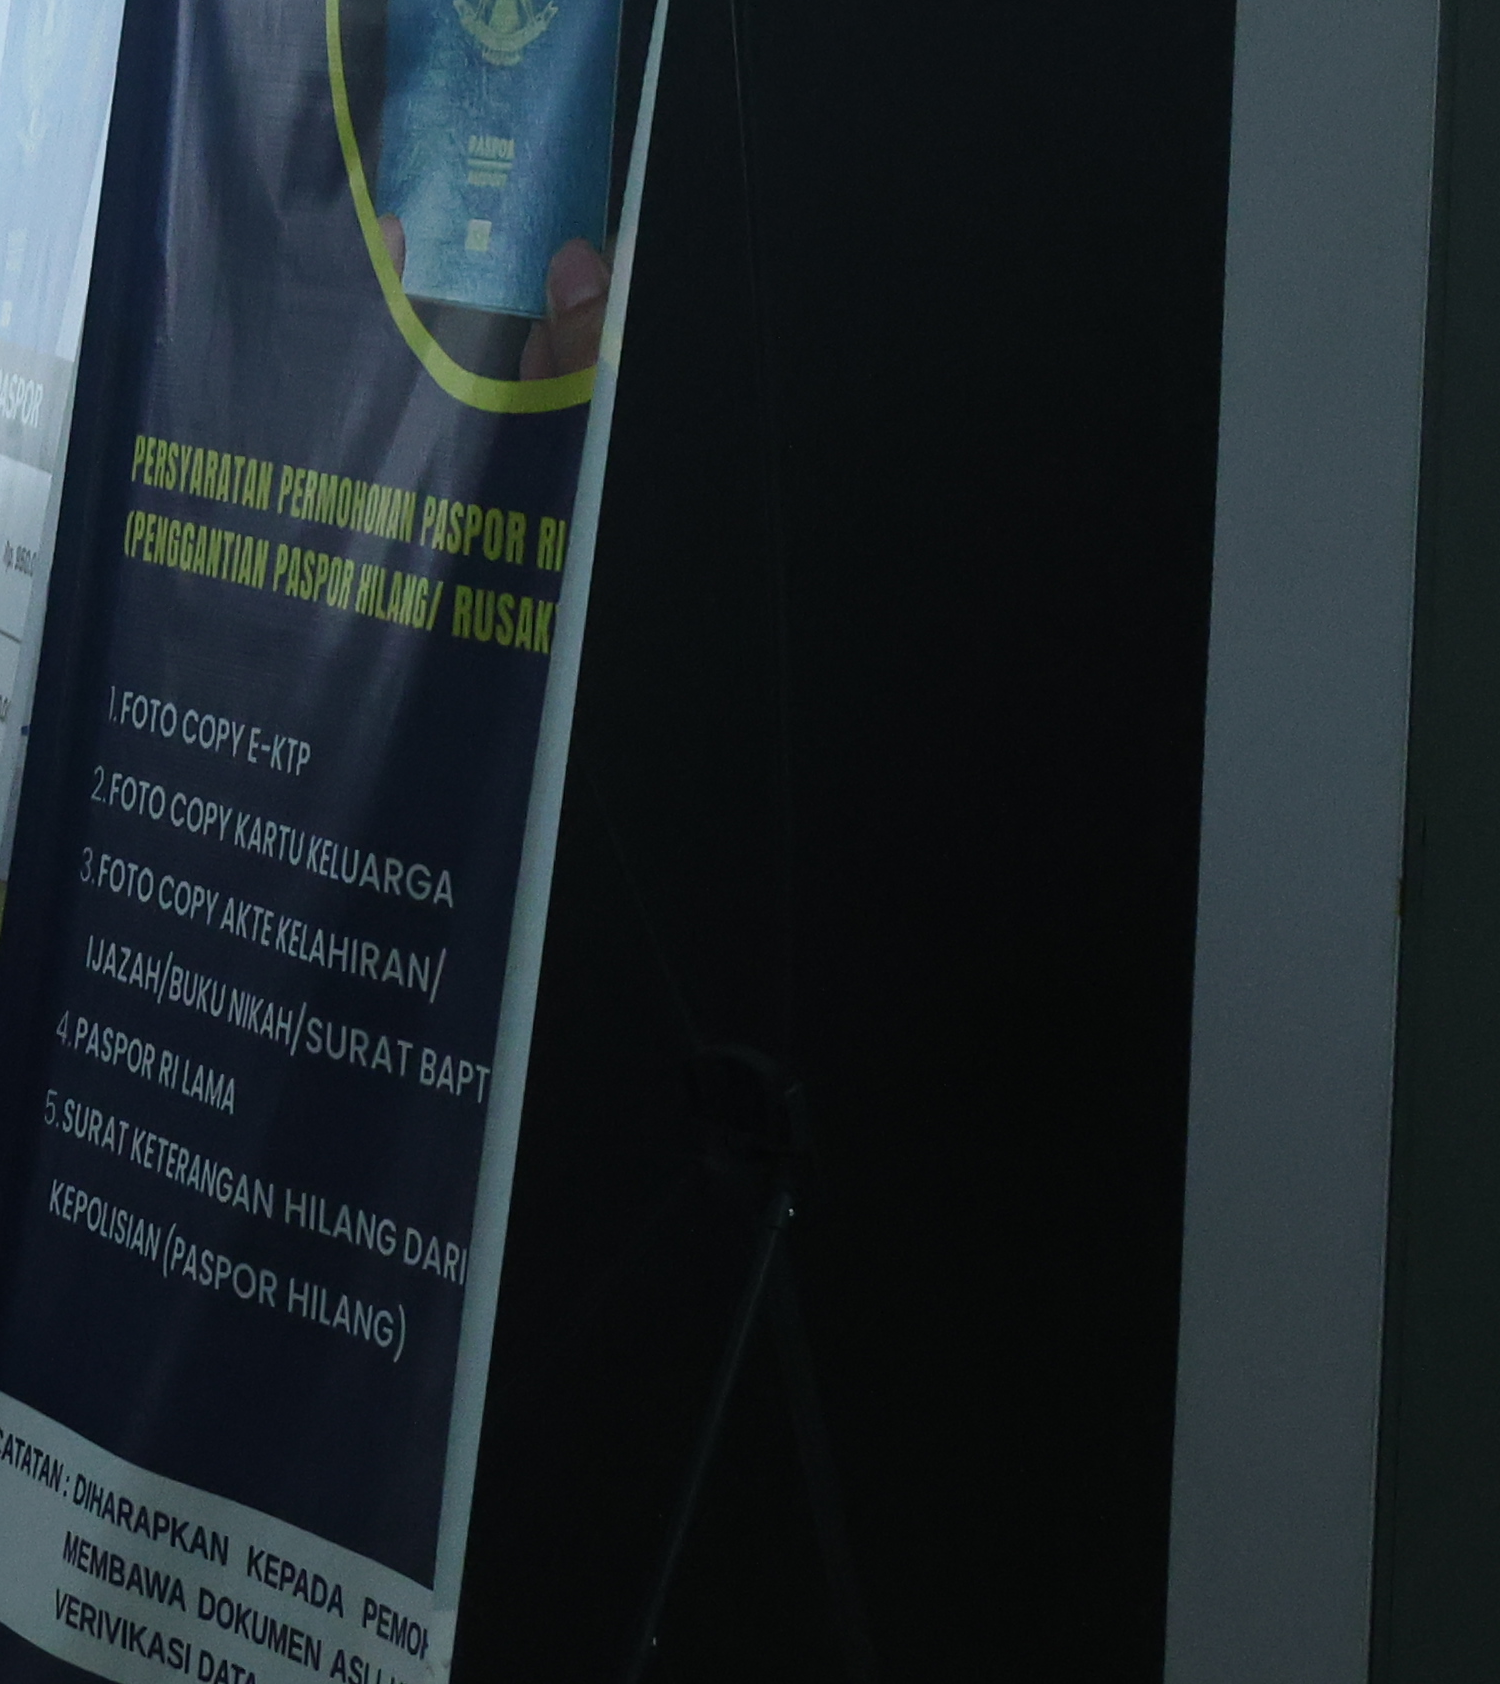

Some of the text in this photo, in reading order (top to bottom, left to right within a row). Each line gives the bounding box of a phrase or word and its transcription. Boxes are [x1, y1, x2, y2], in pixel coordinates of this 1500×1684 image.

[131, 434, 274, 511] PERSYARATAN
[420, 494, 528, 565] PASPOR
[536, 515, 567, 572] RI
[123, 509, 270, 589] (PENGGANTIAN
[272, 542, 356, 610] PASPOR
[451, 584, 559, 655] RUSAK
[182, 708, 246, 758] COPY
[247, 726, 311, 777] E-KTP
[170, 791, 233, 842] COPY
[234, 810, 305, 867] KARTU
[306, 834, 455, 910] KELUARGA
[158, 874, 219, 926] COPY
[220, 897, 274, 947] AKTE
[275, 914, 447, 1004] KELAHIRAN/
[158, 1049, 180, 1091] RI
[181, 1058, 236, 1116] LAMA
[419, 1046, 491, 1105] BAPT
[49, 1178, 407, 1364] KEPOLISIAN (PASPOR HILANG)
[130, 1126, 274, 1219] KETERANGAN
[285, 1187, 398, 1258] HILANG
[403, 1226, 469, 1287] DARI
[63, 1530, 187, 1613] MEMBAWA
[198, 1587, 321, 1672] DOKUMEN
[72, 1472, 230, 1566] DIHARAPKAN
[247, 1544, 344, 1618] KEPADA
[55, 1587, 192, 1674] VERIVIKASI
